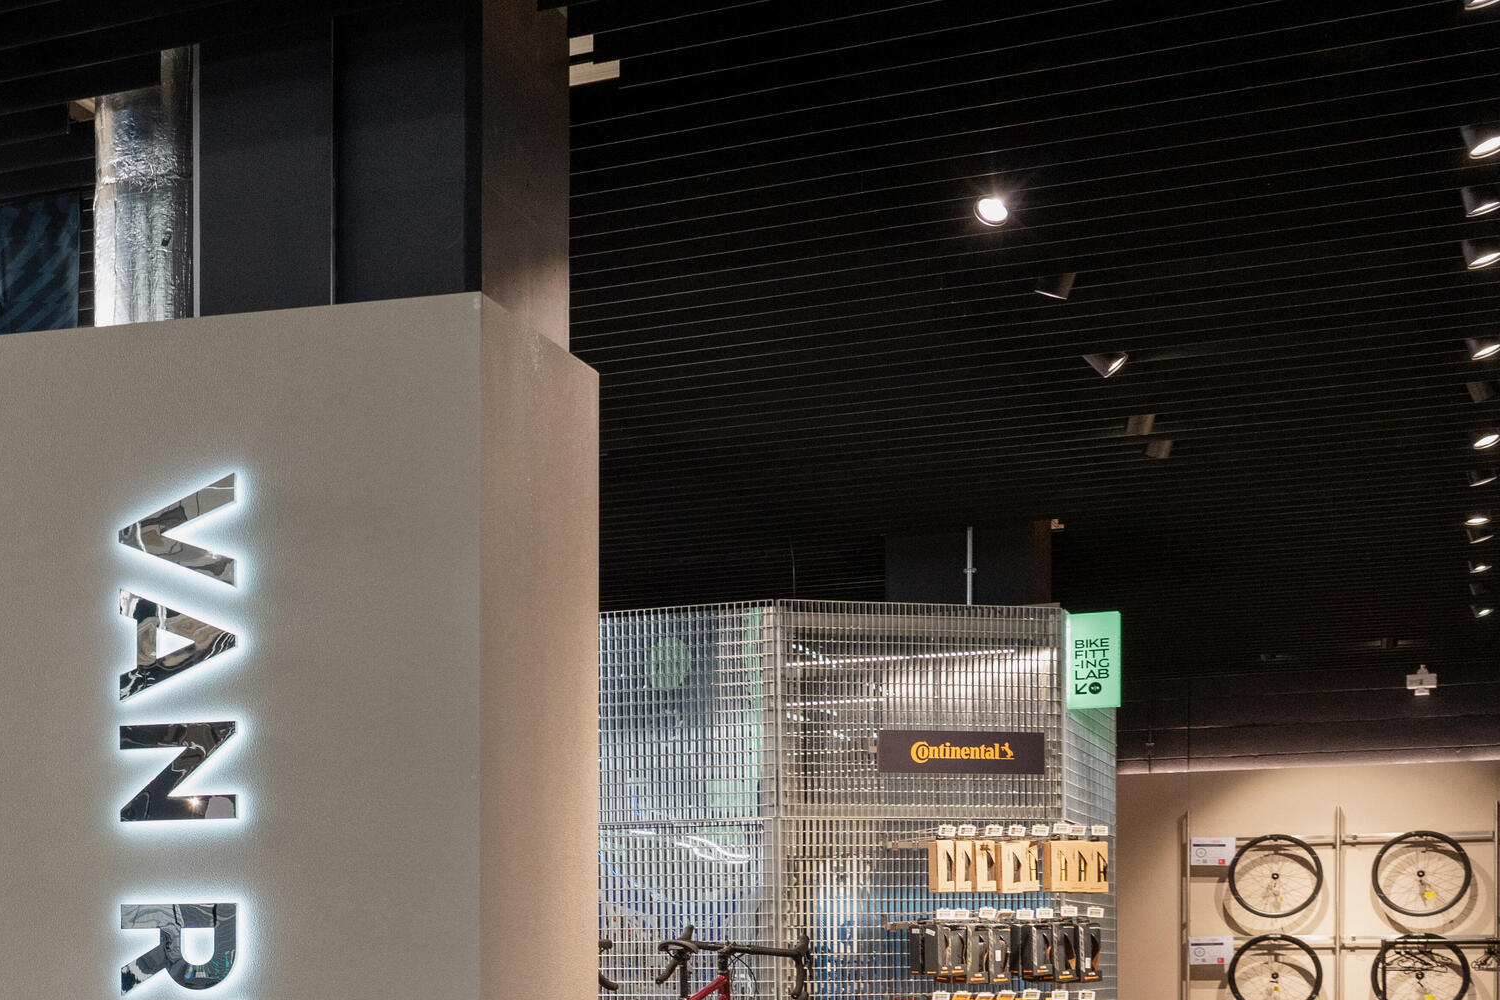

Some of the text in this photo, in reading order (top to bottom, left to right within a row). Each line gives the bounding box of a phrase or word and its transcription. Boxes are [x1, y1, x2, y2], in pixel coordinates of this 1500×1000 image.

[118, 473, 238, 822] VAN
[1075, 638, 1110, 649] BIKE
[1075, 648, 1110, 659] FITT
[1075, 659, 1110, 669] -ING
[1075, 668, 1110, 681] LAB
[910, 740, 1000, 764] Continental
